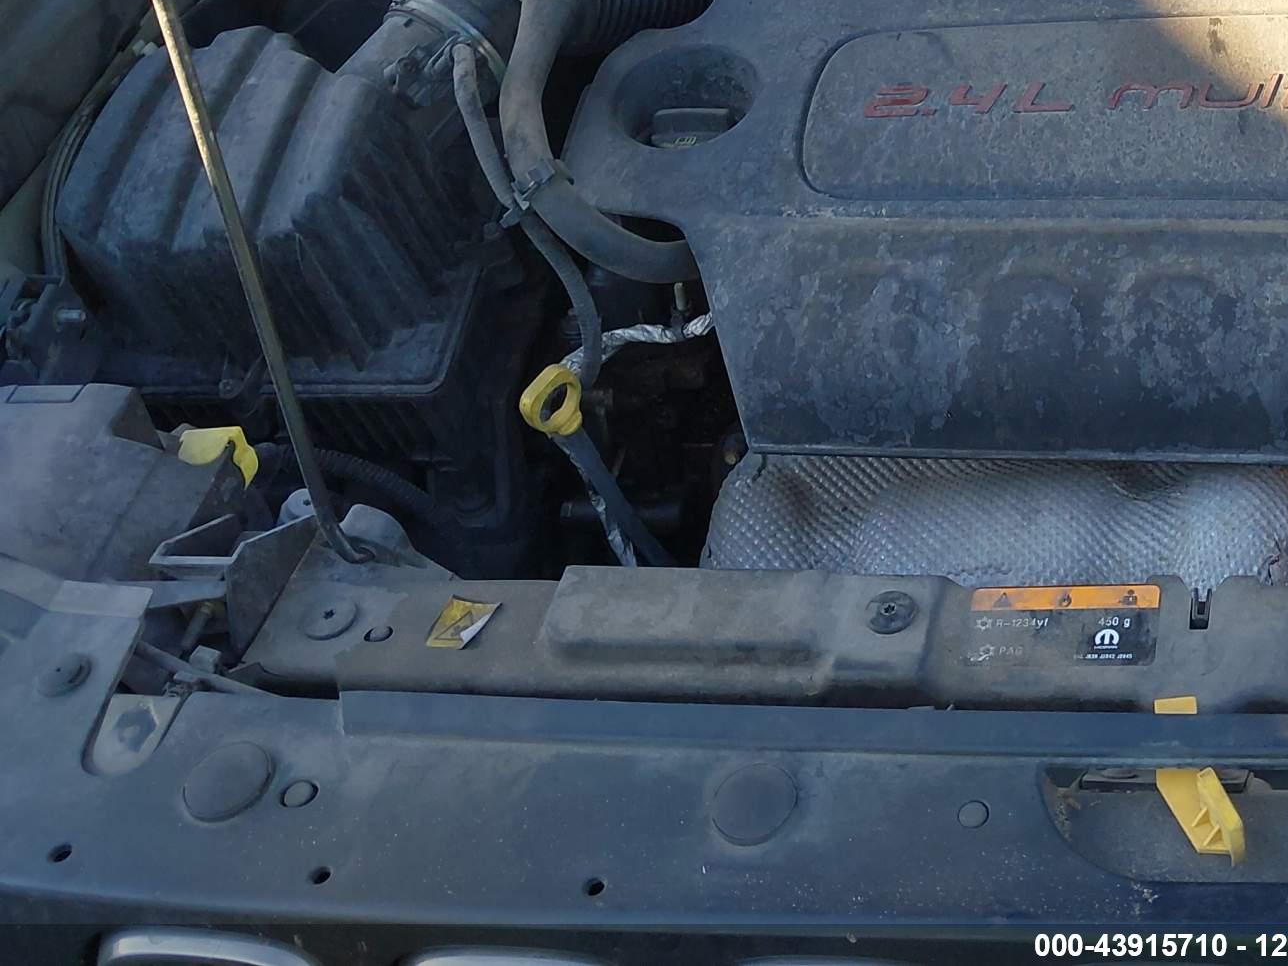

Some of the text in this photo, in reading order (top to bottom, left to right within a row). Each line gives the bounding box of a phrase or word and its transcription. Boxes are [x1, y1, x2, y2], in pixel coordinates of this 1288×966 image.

[863, 80, 1075, 118] 2.4L
[1098, 616, 1131, 628] 450 g
